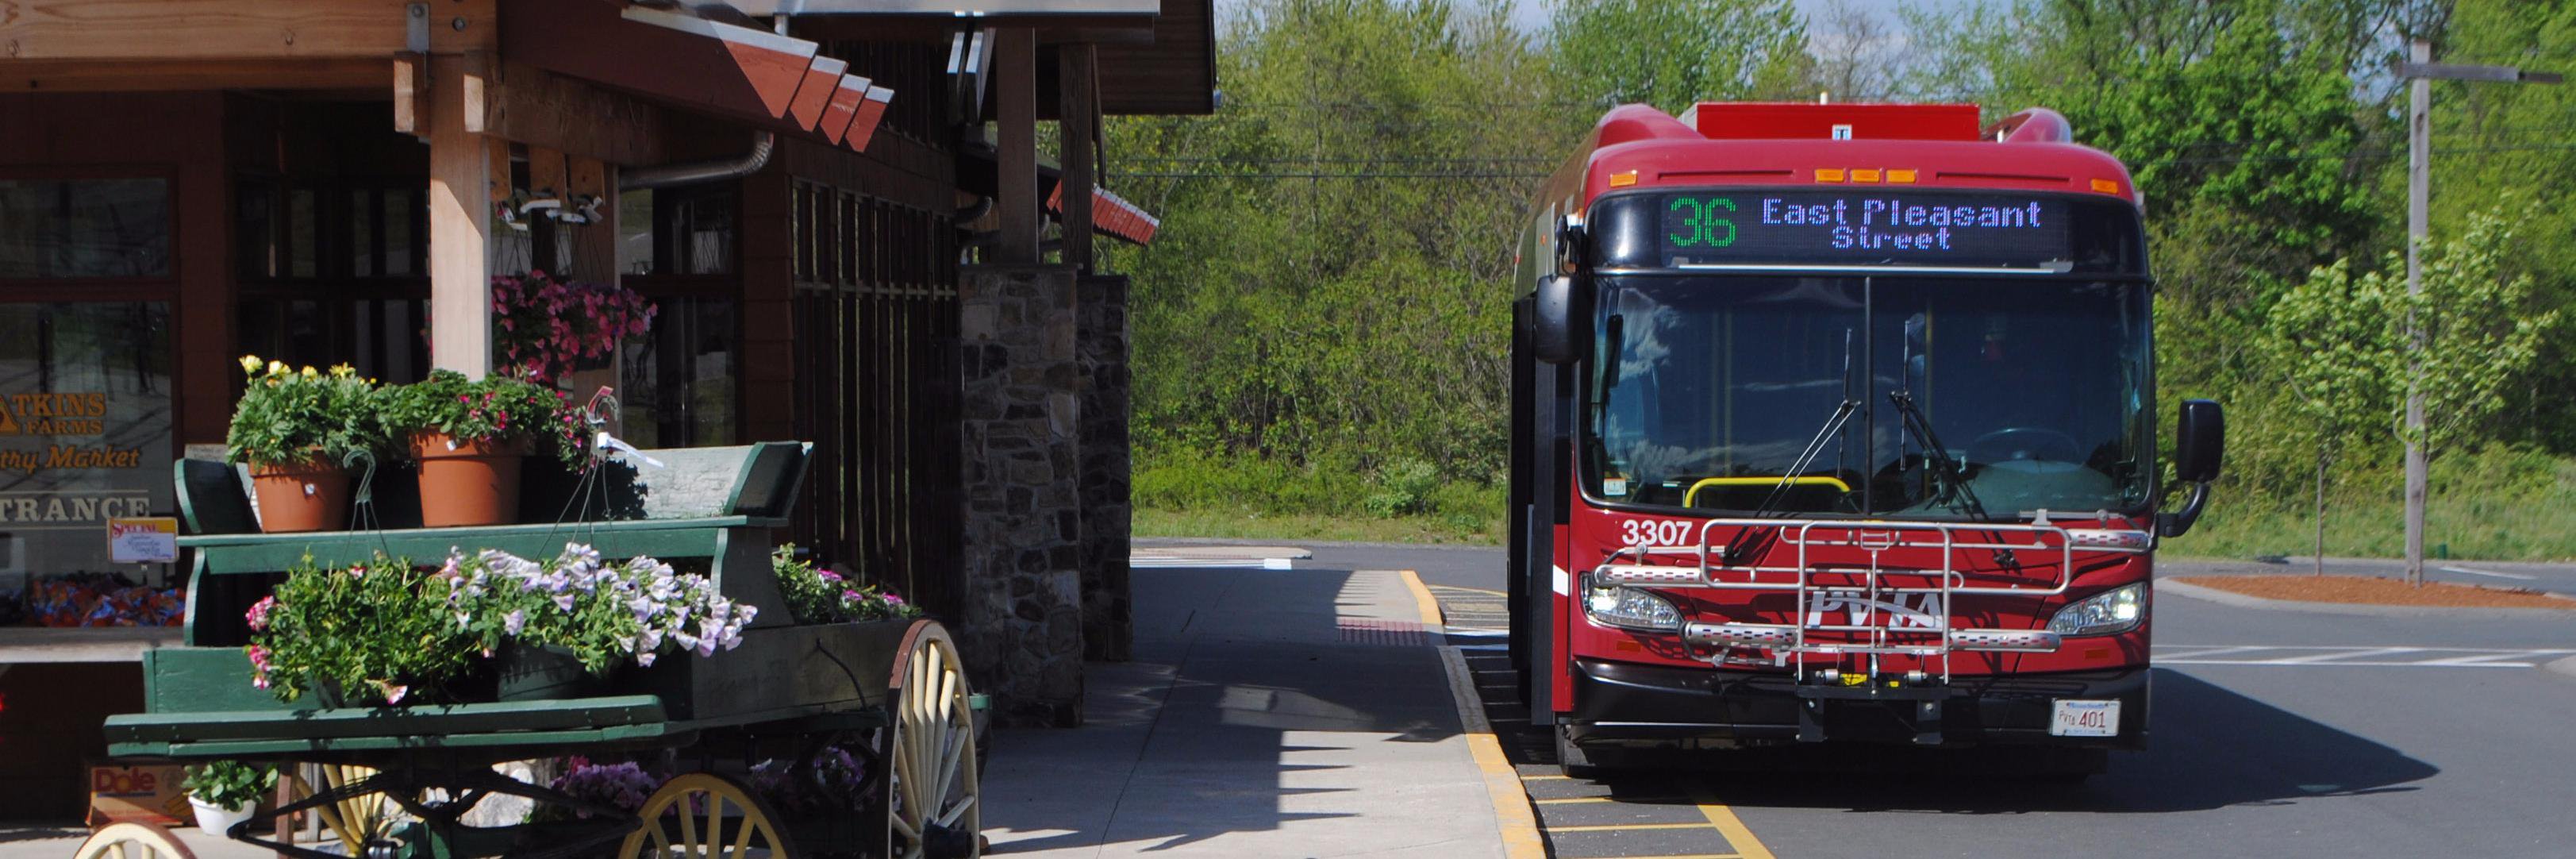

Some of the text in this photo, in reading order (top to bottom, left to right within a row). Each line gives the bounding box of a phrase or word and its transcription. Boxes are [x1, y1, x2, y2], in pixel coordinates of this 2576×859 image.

[1671, 198, 1736, 247] 36
[1763, 198, 2040, 227] East Pleasant
[1832, 225, 1950, 249] Street
[27, 419, 103, 434] FARMS
[45, 445, 140, 468] Market
[1622, 519, 1692, 545] 3307
[1805, 590, 1944, 629] PVTA
[2078, 710, 2106, 728] 401
[95, 767, 156, 793] Dole
